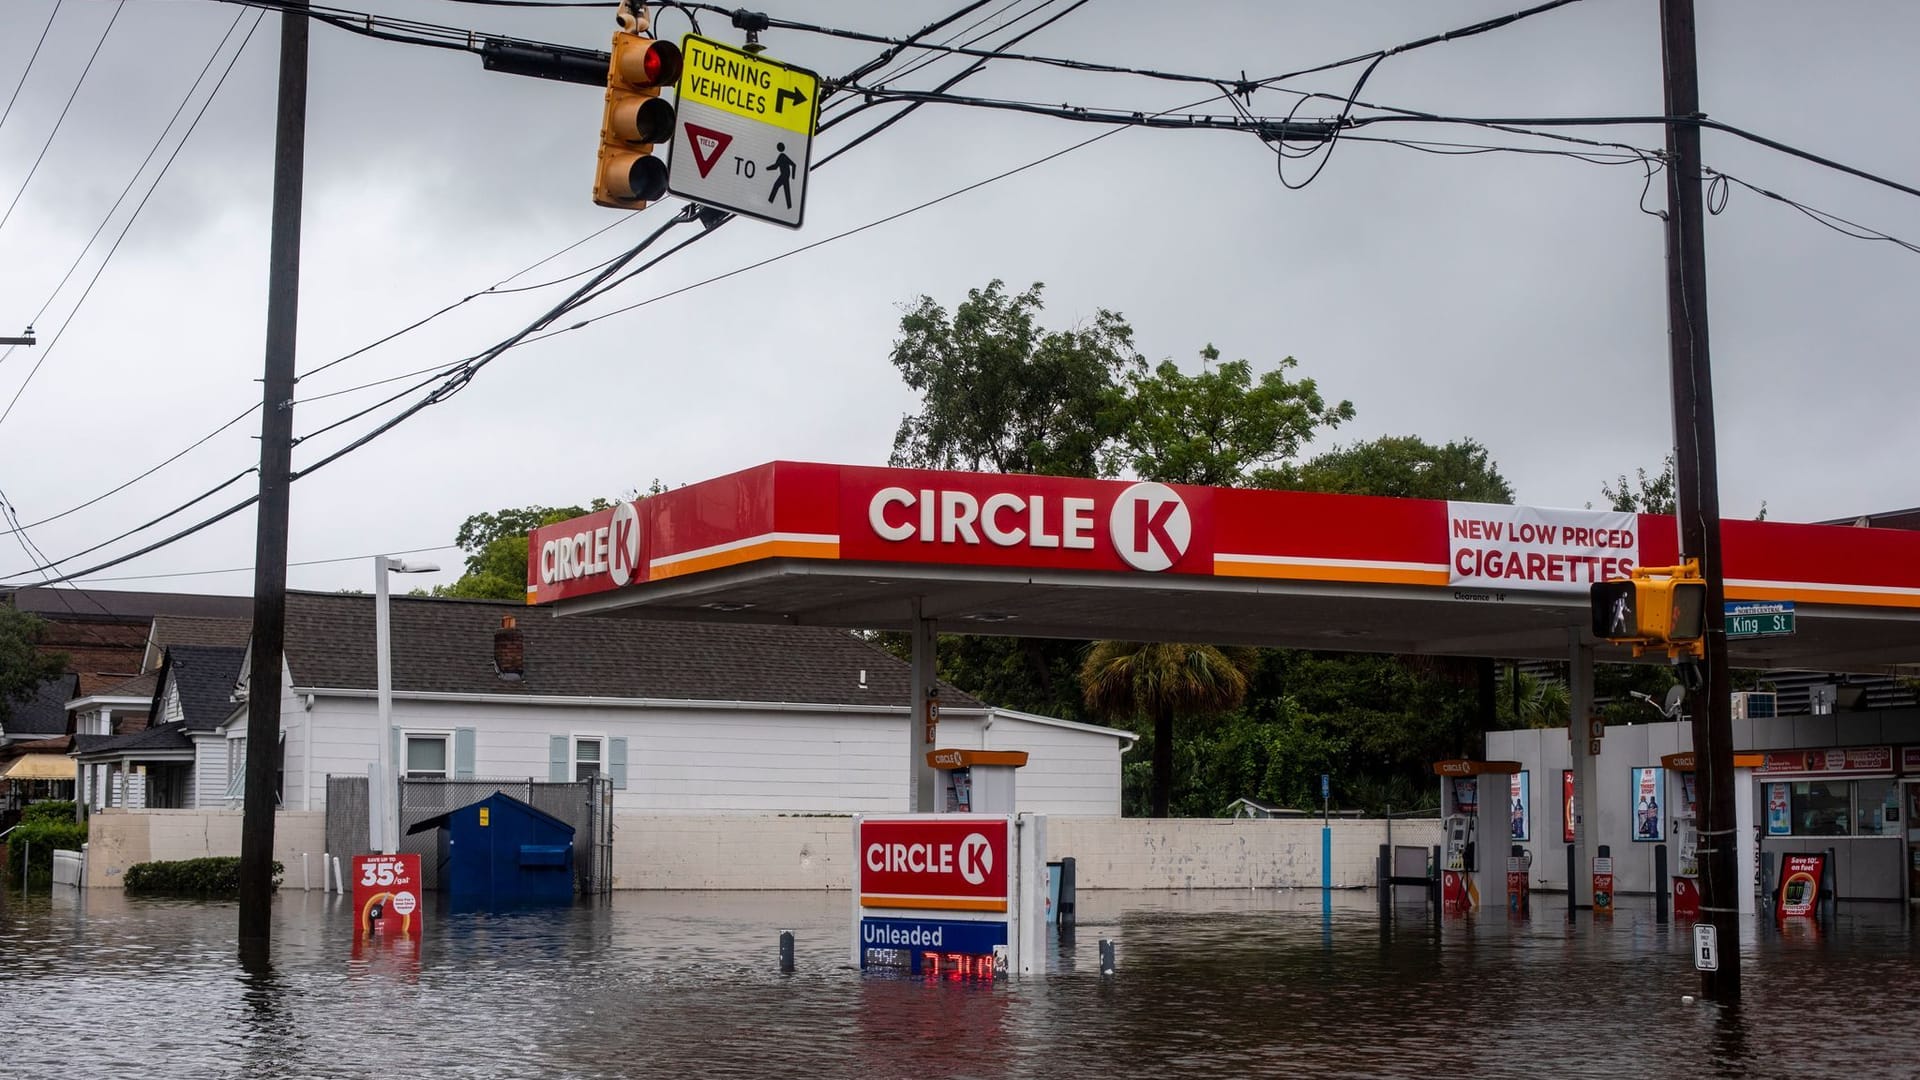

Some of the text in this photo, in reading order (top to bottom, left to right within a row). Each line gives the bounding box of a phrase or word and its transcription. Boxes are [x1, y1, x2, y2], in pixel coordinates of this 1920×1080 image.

[691, 48, 772, 89] TURNING
[690, 74, 766, 114] VEHICLES
[699, 138, 716, 148] YIELD
[734, 157, 756, 178] TO
[868, 486, 1184, 567] CIRCLE K
[1453, 519, 1634, 549] NEW LOW PRICED
[541, 527, 608, 585] CIRCLE
[1455, 548, 1634, 583] CIGARETTES
[1454, 591, 1490, 601] Clearance
[1733, 615, 1786, 633] King St
[935, 754, 954, 764] CIRCLE
[1443, 764, 1462, 772] CIRCLE
[1673, 820, 1678, 834] 2
[361, 861, 404, 886] 35¢
[866, 843, 991, 881] CIRCLE K
[863, 924, 943, 946] Unleaded
